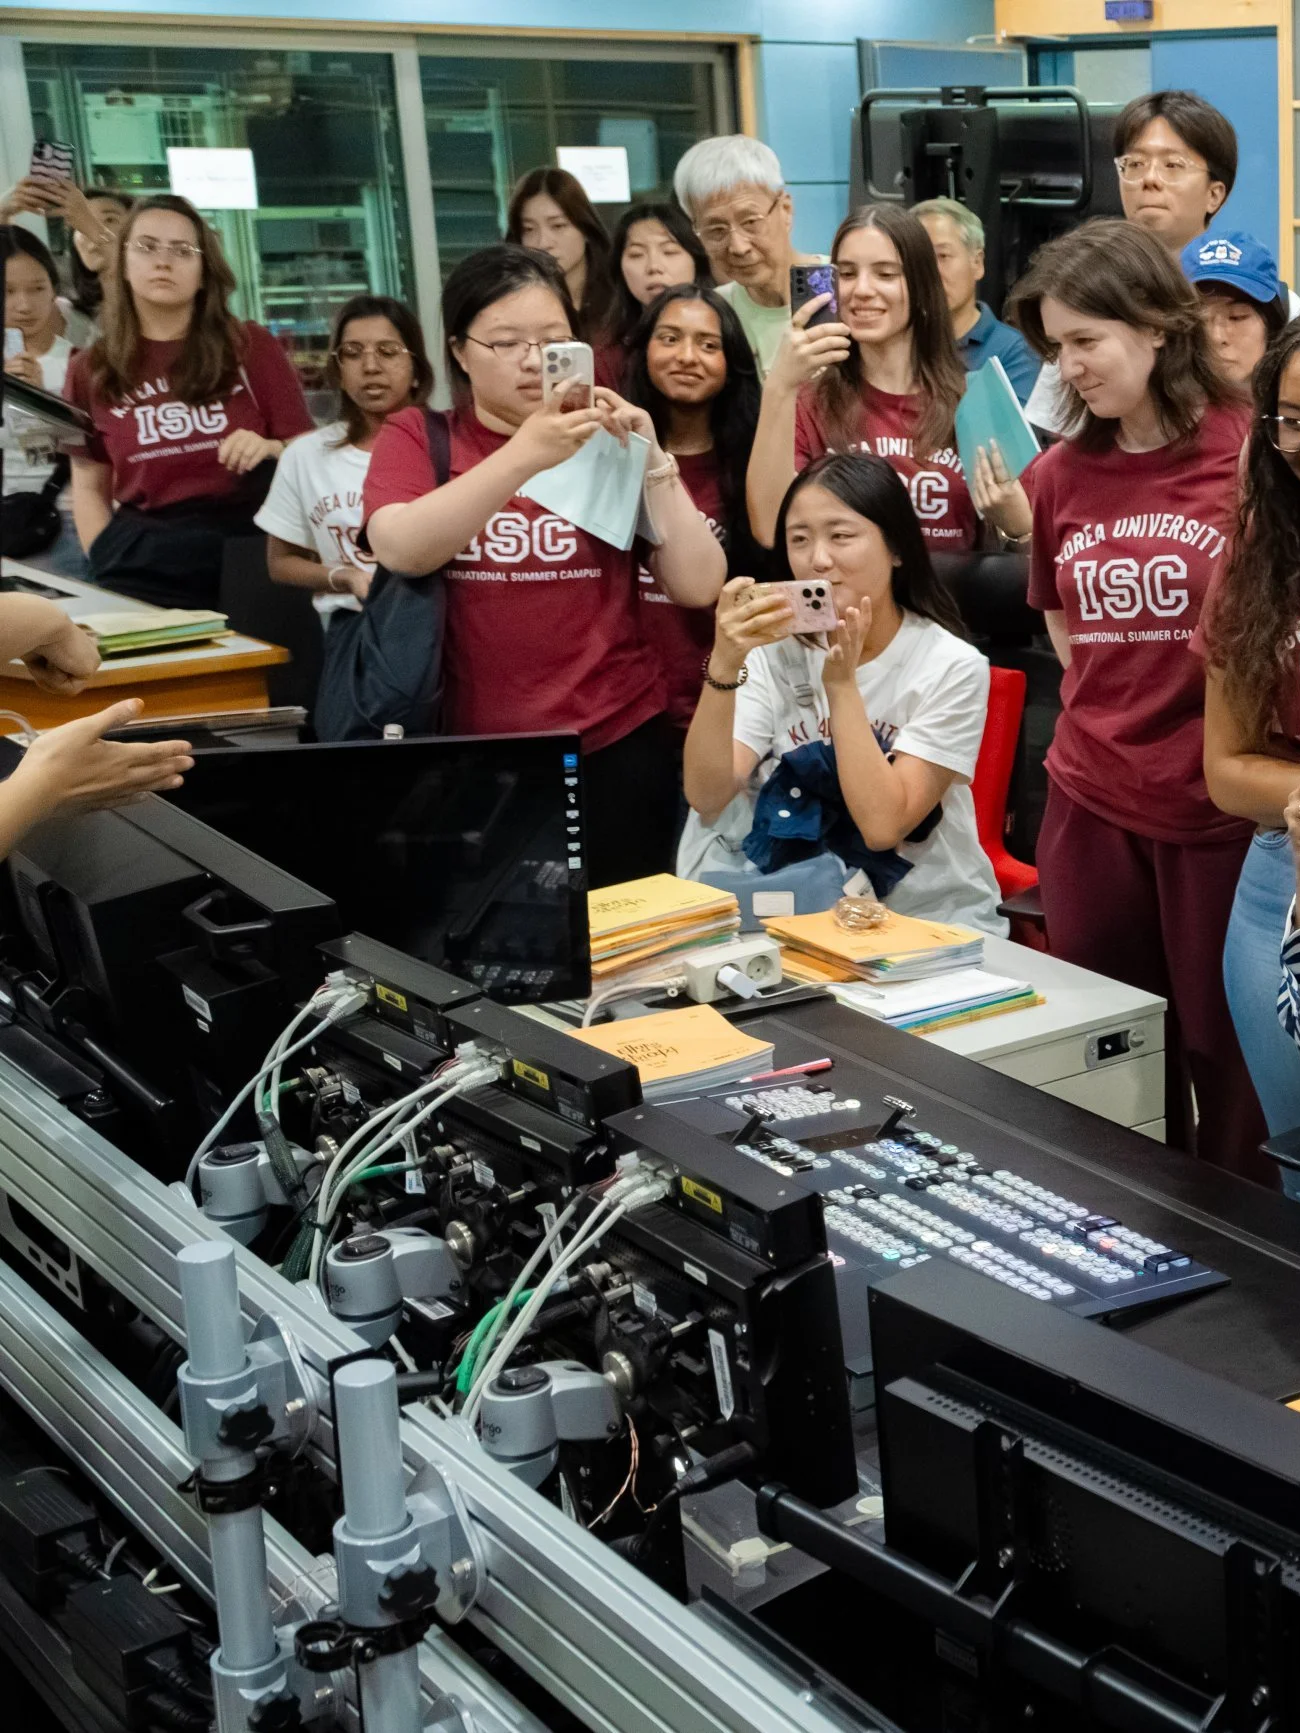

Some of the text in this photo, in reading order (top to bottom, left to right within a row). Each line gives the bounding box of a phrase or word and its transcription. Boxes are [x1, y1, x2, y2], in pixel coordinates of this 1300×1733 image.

[134, 401, 228, 445] ISC
[1112, 513, 1227, 559] UNIVERSITY
[510, 569, 559, 582] SUMMER
[560, 568, 603, 582] CAMPUS
[1073, 555, 1189, 621] ISC
[1127, 629, 1171, 643] SUMMER
